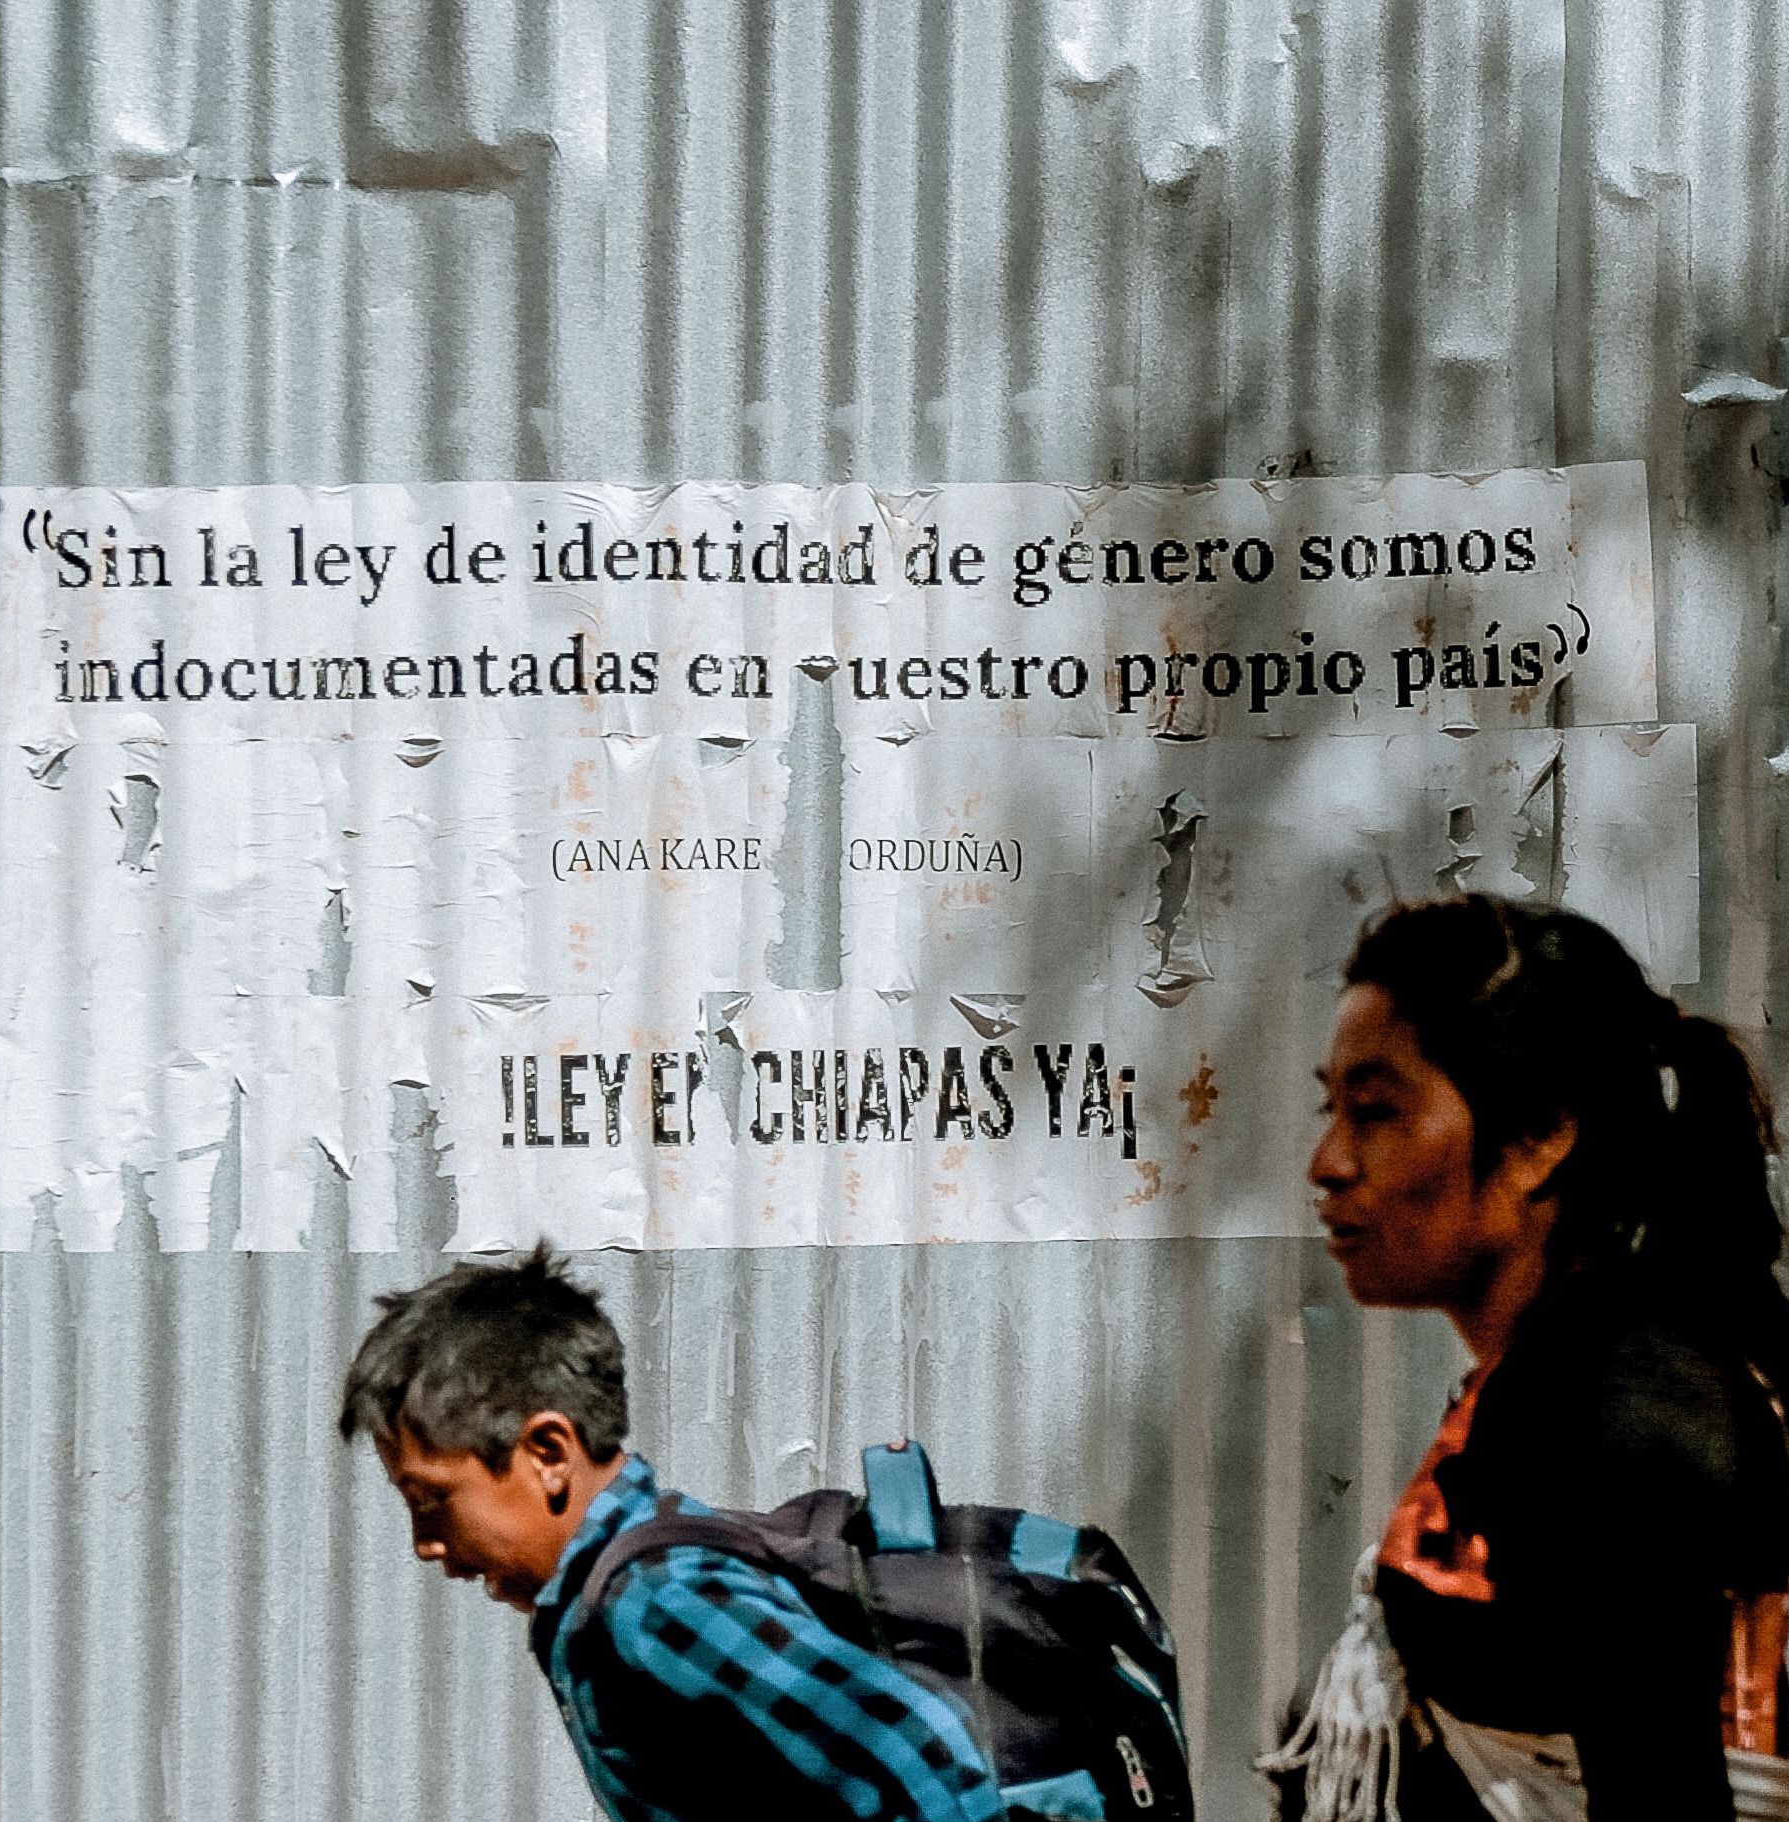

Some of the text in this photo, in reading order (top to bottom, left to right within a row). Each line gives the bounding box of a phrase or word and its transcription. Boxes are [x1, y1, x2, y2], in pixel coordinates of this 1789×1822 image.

[198, 527, 262, 588] la
[289, 523, 398, 608] ley
[425, 523, 508, 587] de
[533, 520, 876, 588] identidad
[904, 523, 985, 588] de
[1012, 520, 1275, 608] género
[1298, 524, 1537, 583] somos
[53, 632, 660, 705] indocumentadas
[686, 653, 774, 699] en
[800, 646, 1090, 702] uestro
[1113, 630, 1368, 714] propio
[552, 831, 1025, 883] (ANA KARE ORDUÑA)
[750, 1043, 1015, 1143] CHIAPAS
